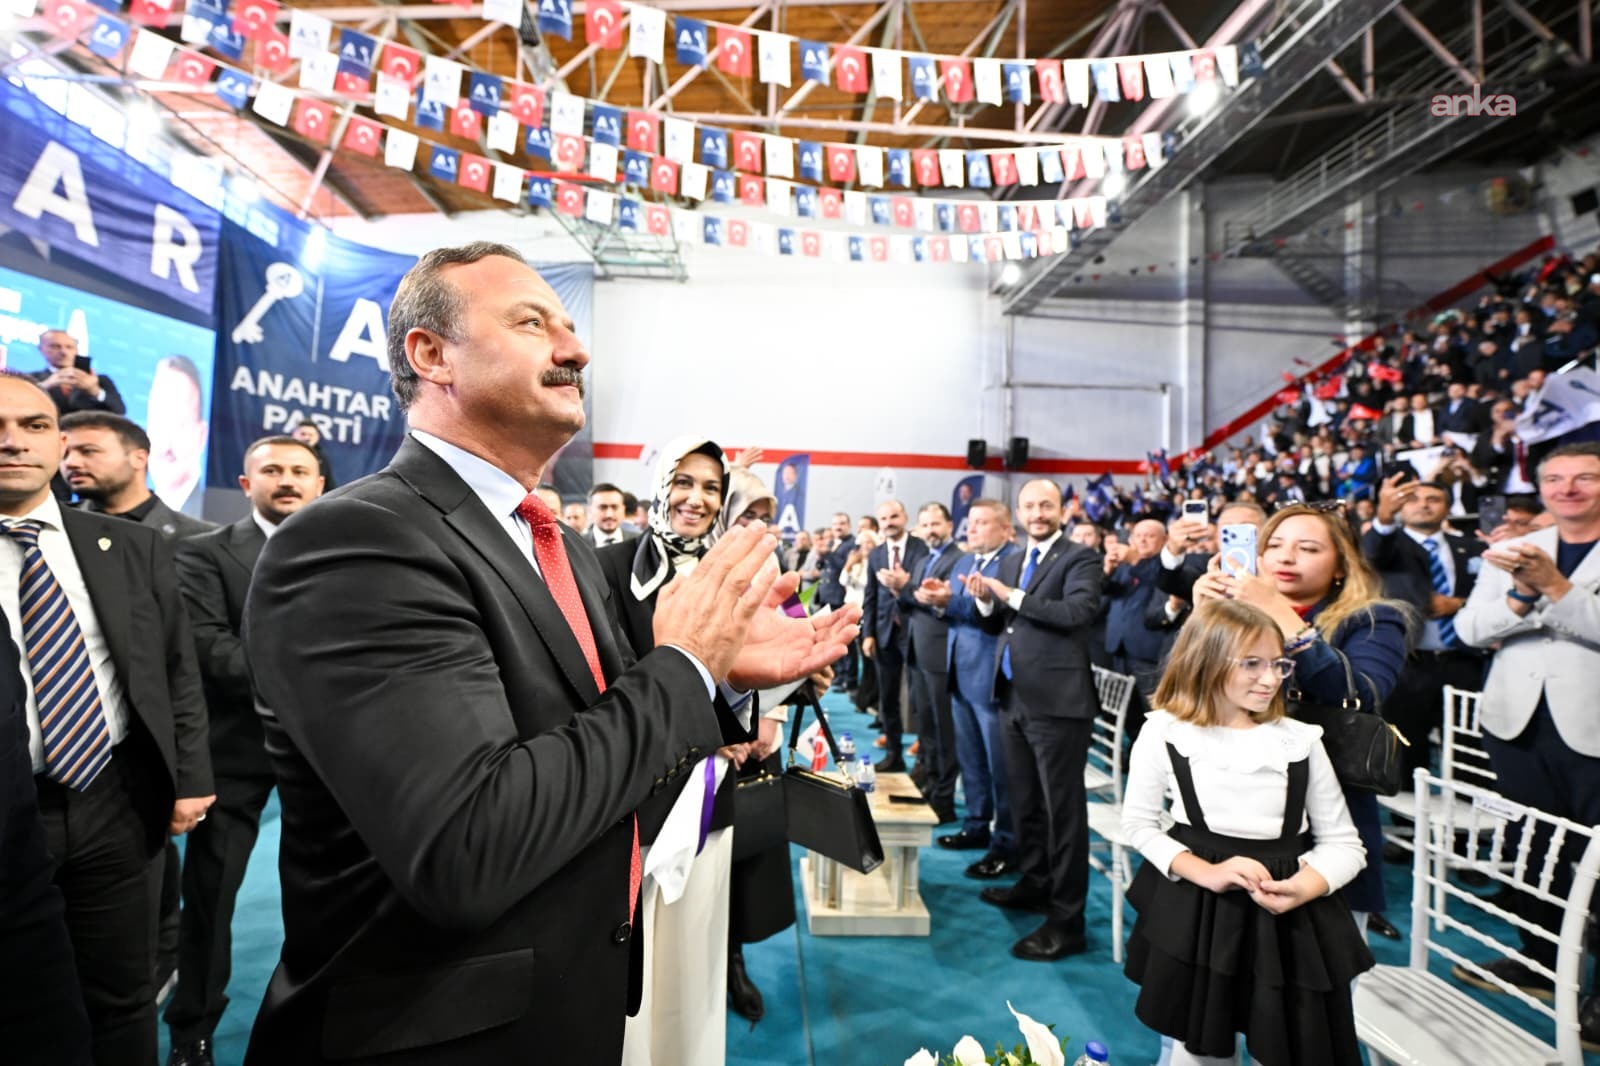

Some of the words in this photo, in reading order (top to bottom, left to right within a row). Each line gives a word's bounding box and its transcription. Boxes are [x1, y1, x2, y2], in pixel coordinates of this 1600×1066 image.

[329, 298, 391, 373] A
[230, 365, 391, 421] ANAHTAR
[778, 503, 799, 532] A
